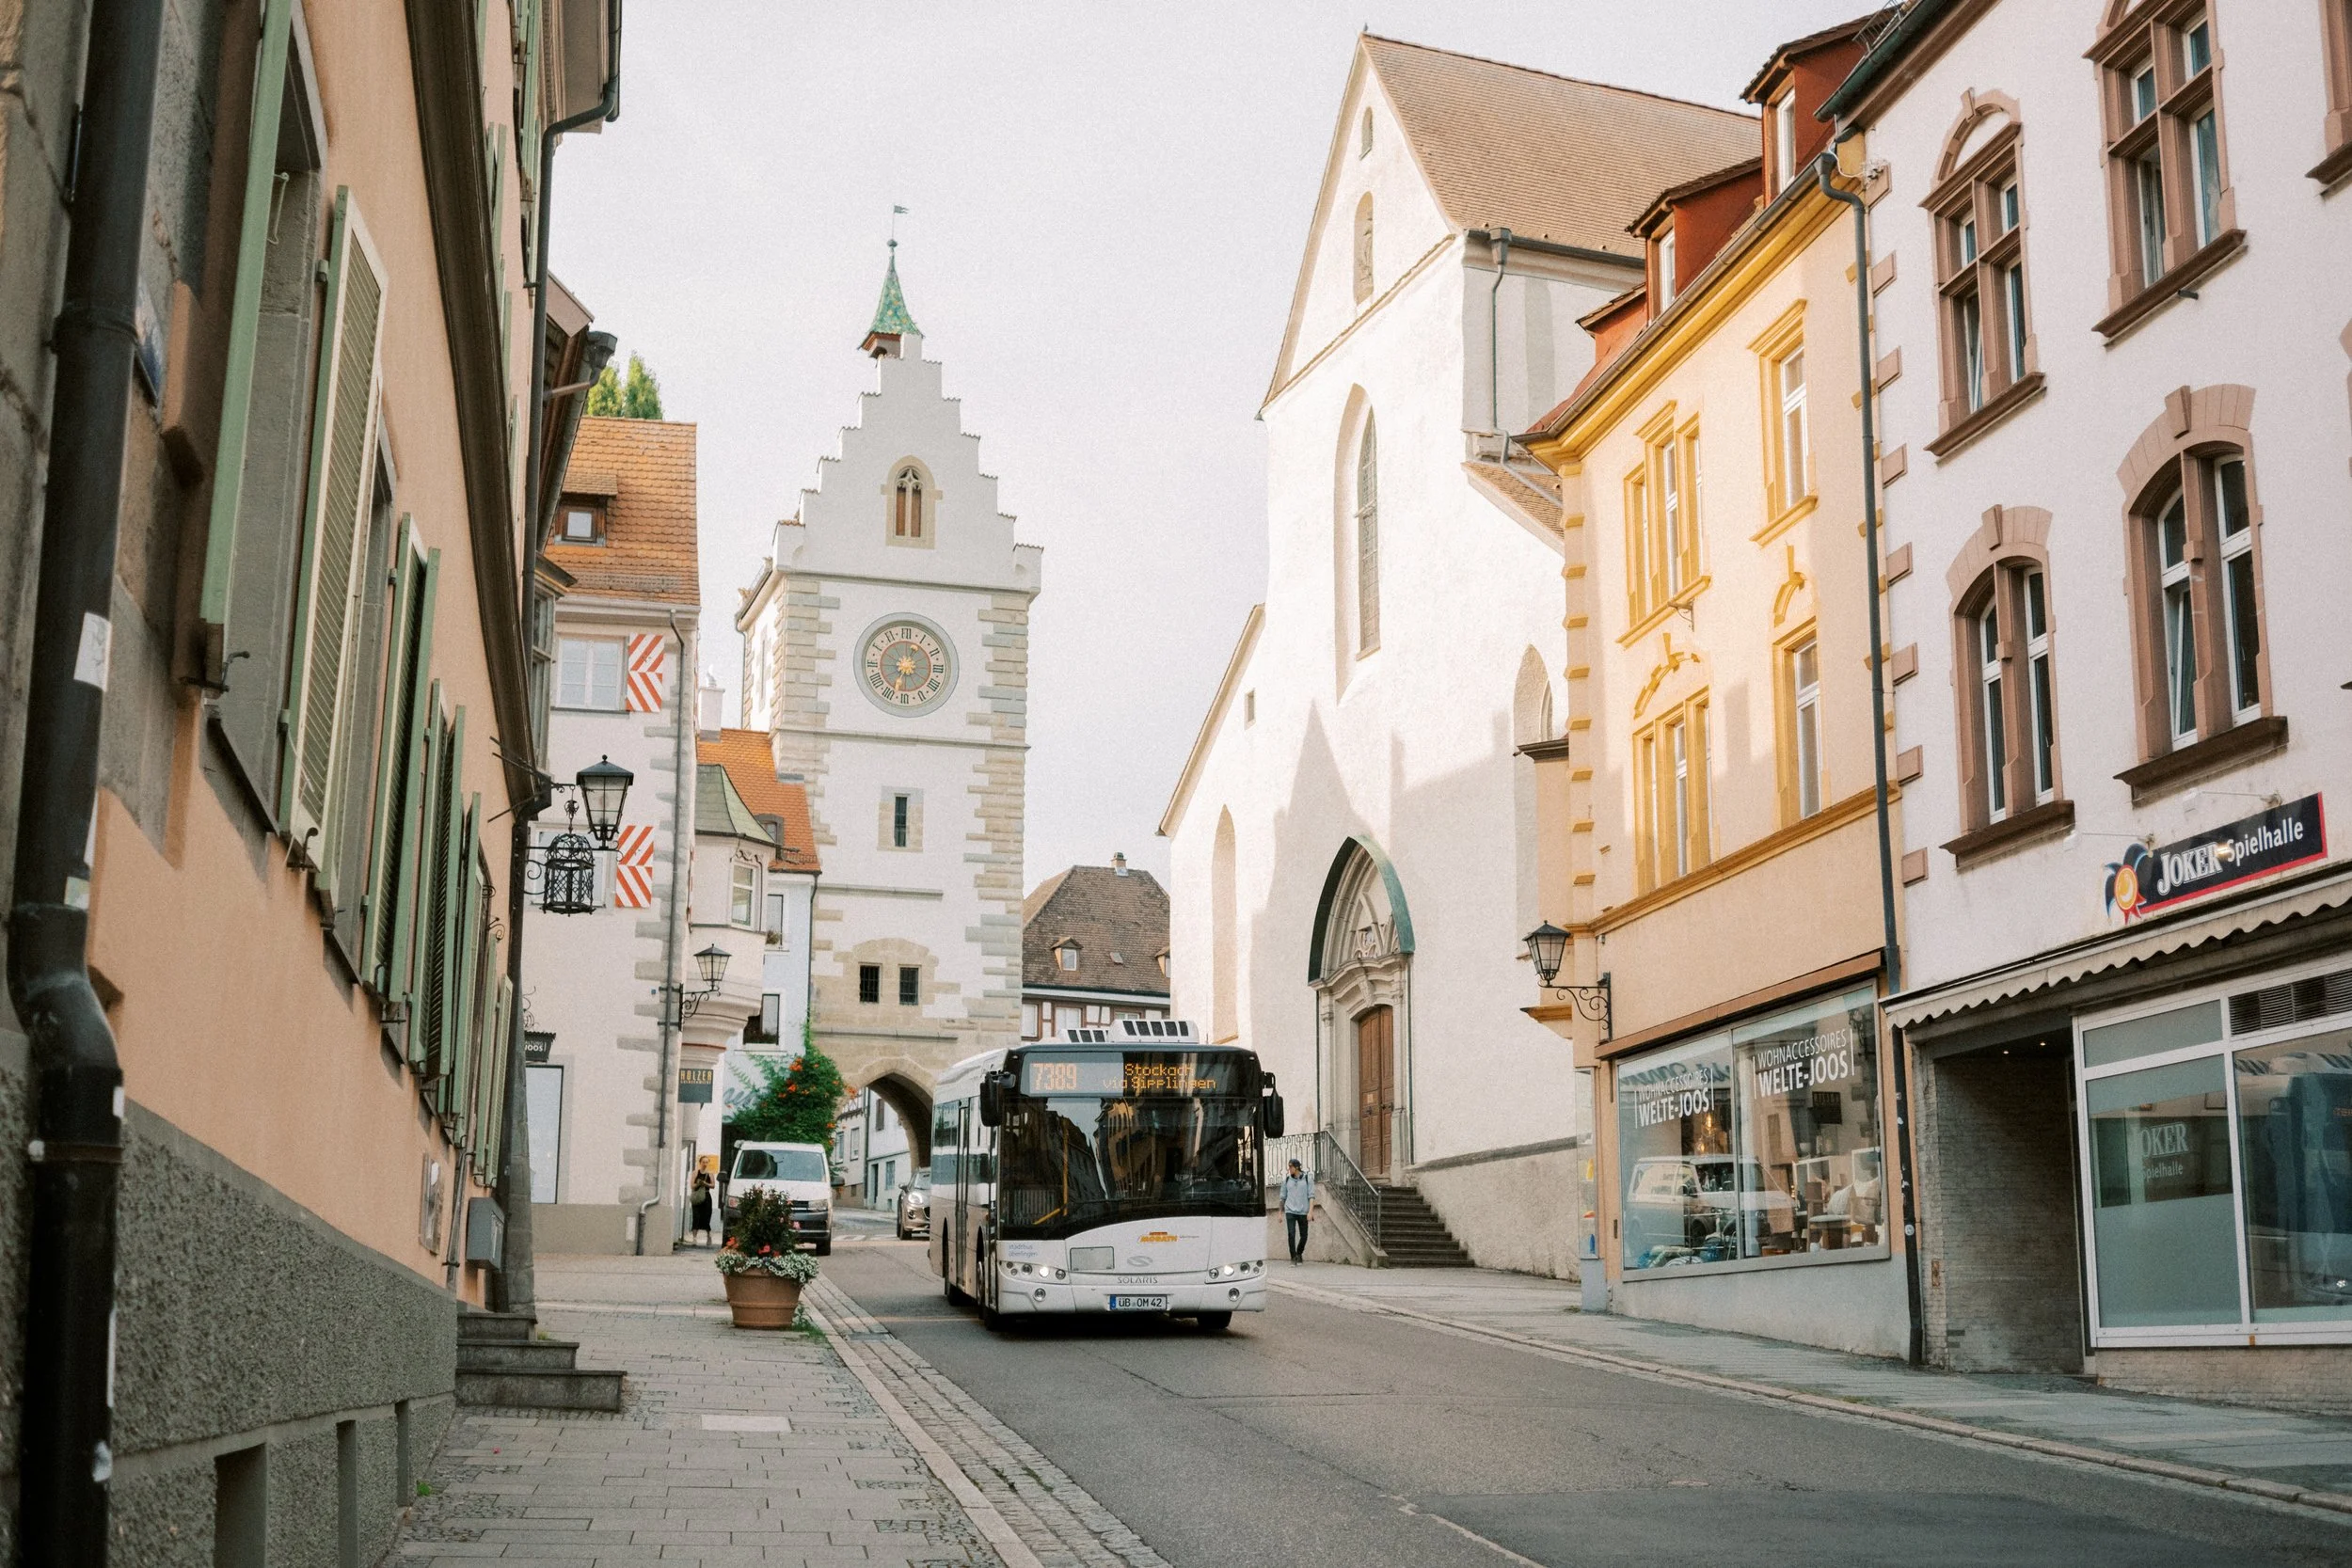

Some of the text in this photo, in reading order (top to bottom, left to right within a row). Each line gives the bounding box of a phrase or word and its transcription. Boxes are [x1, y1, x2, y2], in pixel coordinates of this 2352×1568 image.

[2157, 816, 2304, 895] JOKER Spielhalle
[1757, 1029, 1847, 1069] WOHNACCESSOIRES
[1032, 1063, 1077, 1091] 7389
[1124, 1063, 1194, 1076] Stockach
[1639, 1068, 1708, 1102] WOHNACCESSOIRES
[1758, 1050, 1849, 1098] WELTE-JOOS
[1639, 1087, 1709, 1127] WELTE-JOOS
[2141, 1121, 2189, 1158] OKER
[2145, 1161, 2184, 1182] pielhalle
[1136, 1298, 1149, 1307] OM
[1151, 1298, 1162, 1307] 42
